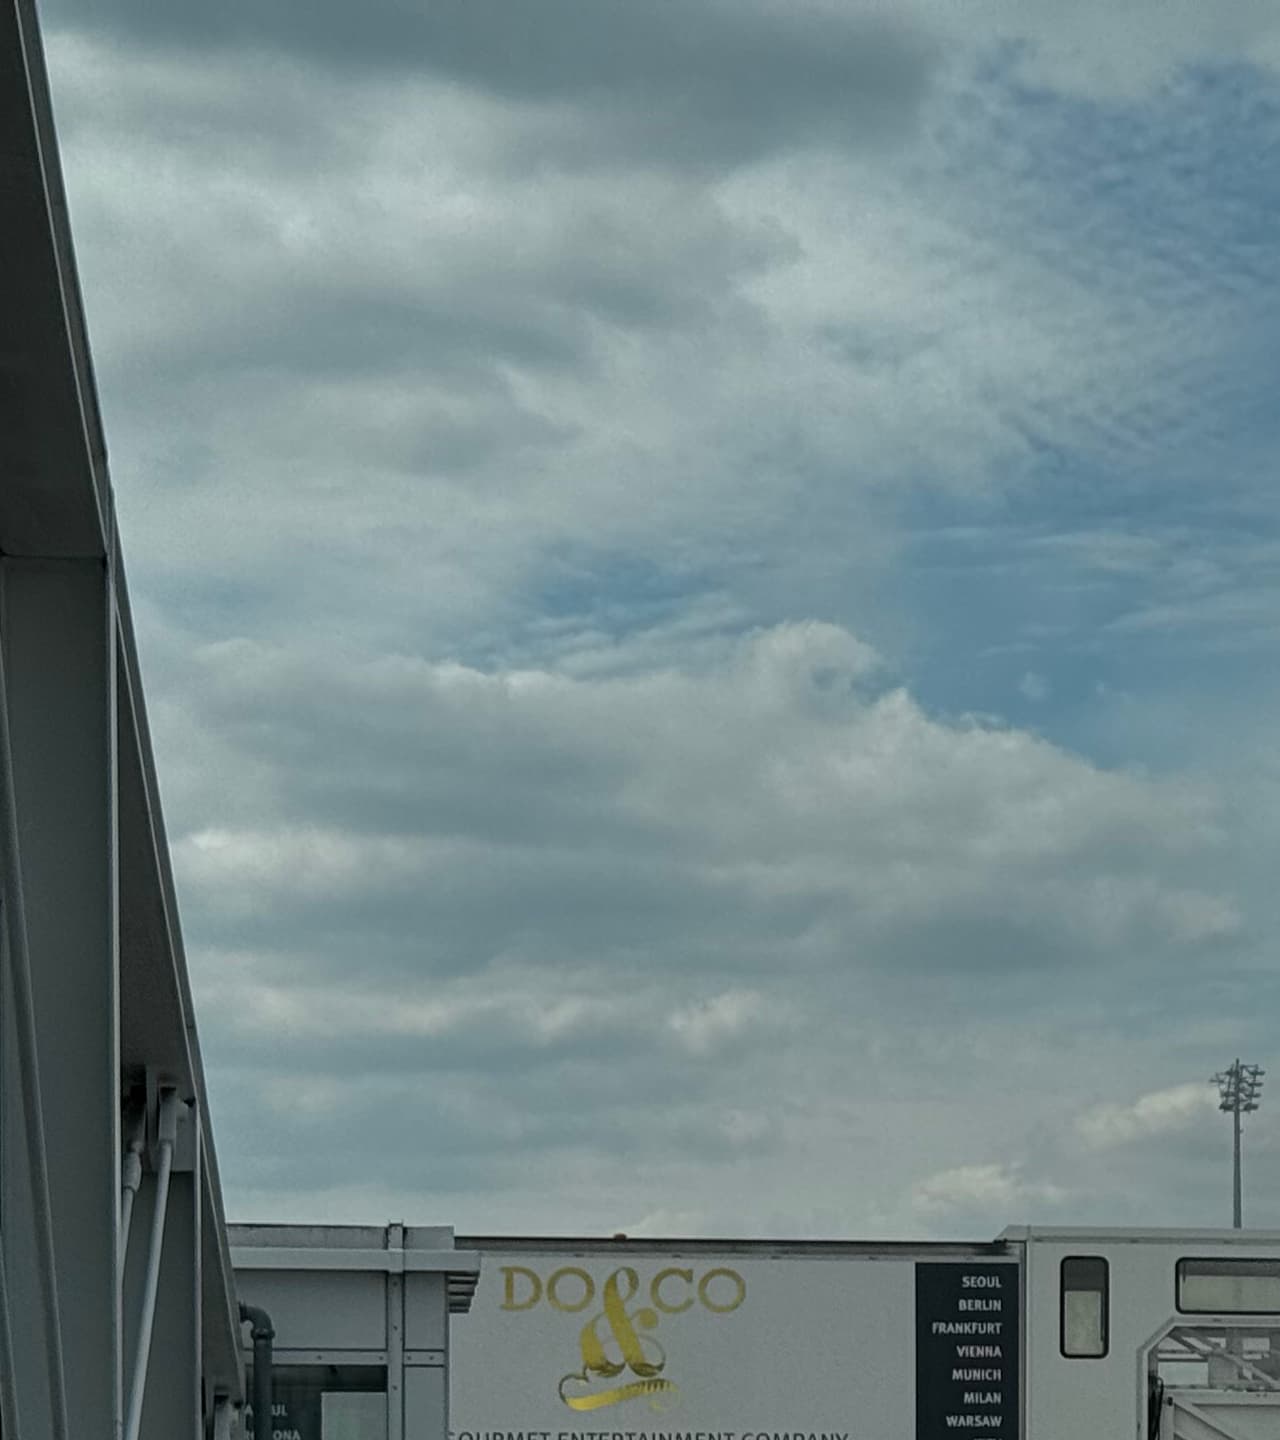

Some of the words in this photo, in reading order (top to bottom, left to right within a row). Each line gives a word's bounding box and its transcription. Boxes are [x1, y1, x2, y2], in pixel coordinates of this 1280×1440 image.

[961, 1275, 1002, 1288] SEOUL
[958, 1299, 1002, 1311] BERLIN
[931, 1321, 1003, 1334] FRANKFURT
[956, 1344, 1002, 1357] VIENNA
[952, 1368, 1002, 1381] MUNICH
[963, 1391, 1002, 1404] MILAN
[946, 1415, 1002, 1427] WARSAW
